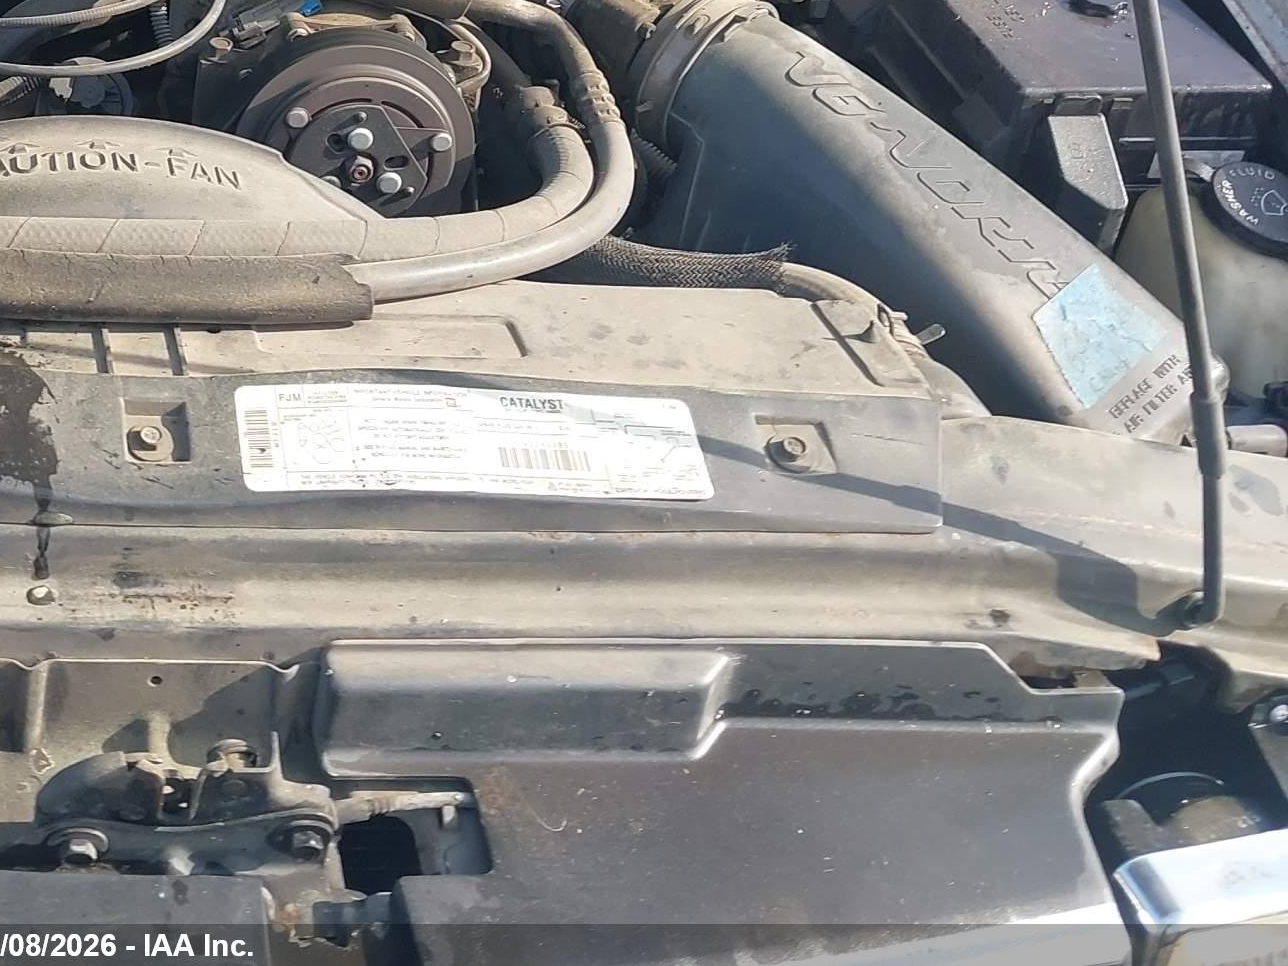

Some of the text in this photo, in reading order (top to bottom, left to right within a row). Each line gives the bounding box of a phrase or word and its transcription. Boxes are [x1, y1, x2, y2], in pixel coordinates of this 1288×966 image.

[1221, 179, 1259, 225] WASHER
[278, 393, 302, 407] FJM
[499, 396, 564, 410] CATALYST
